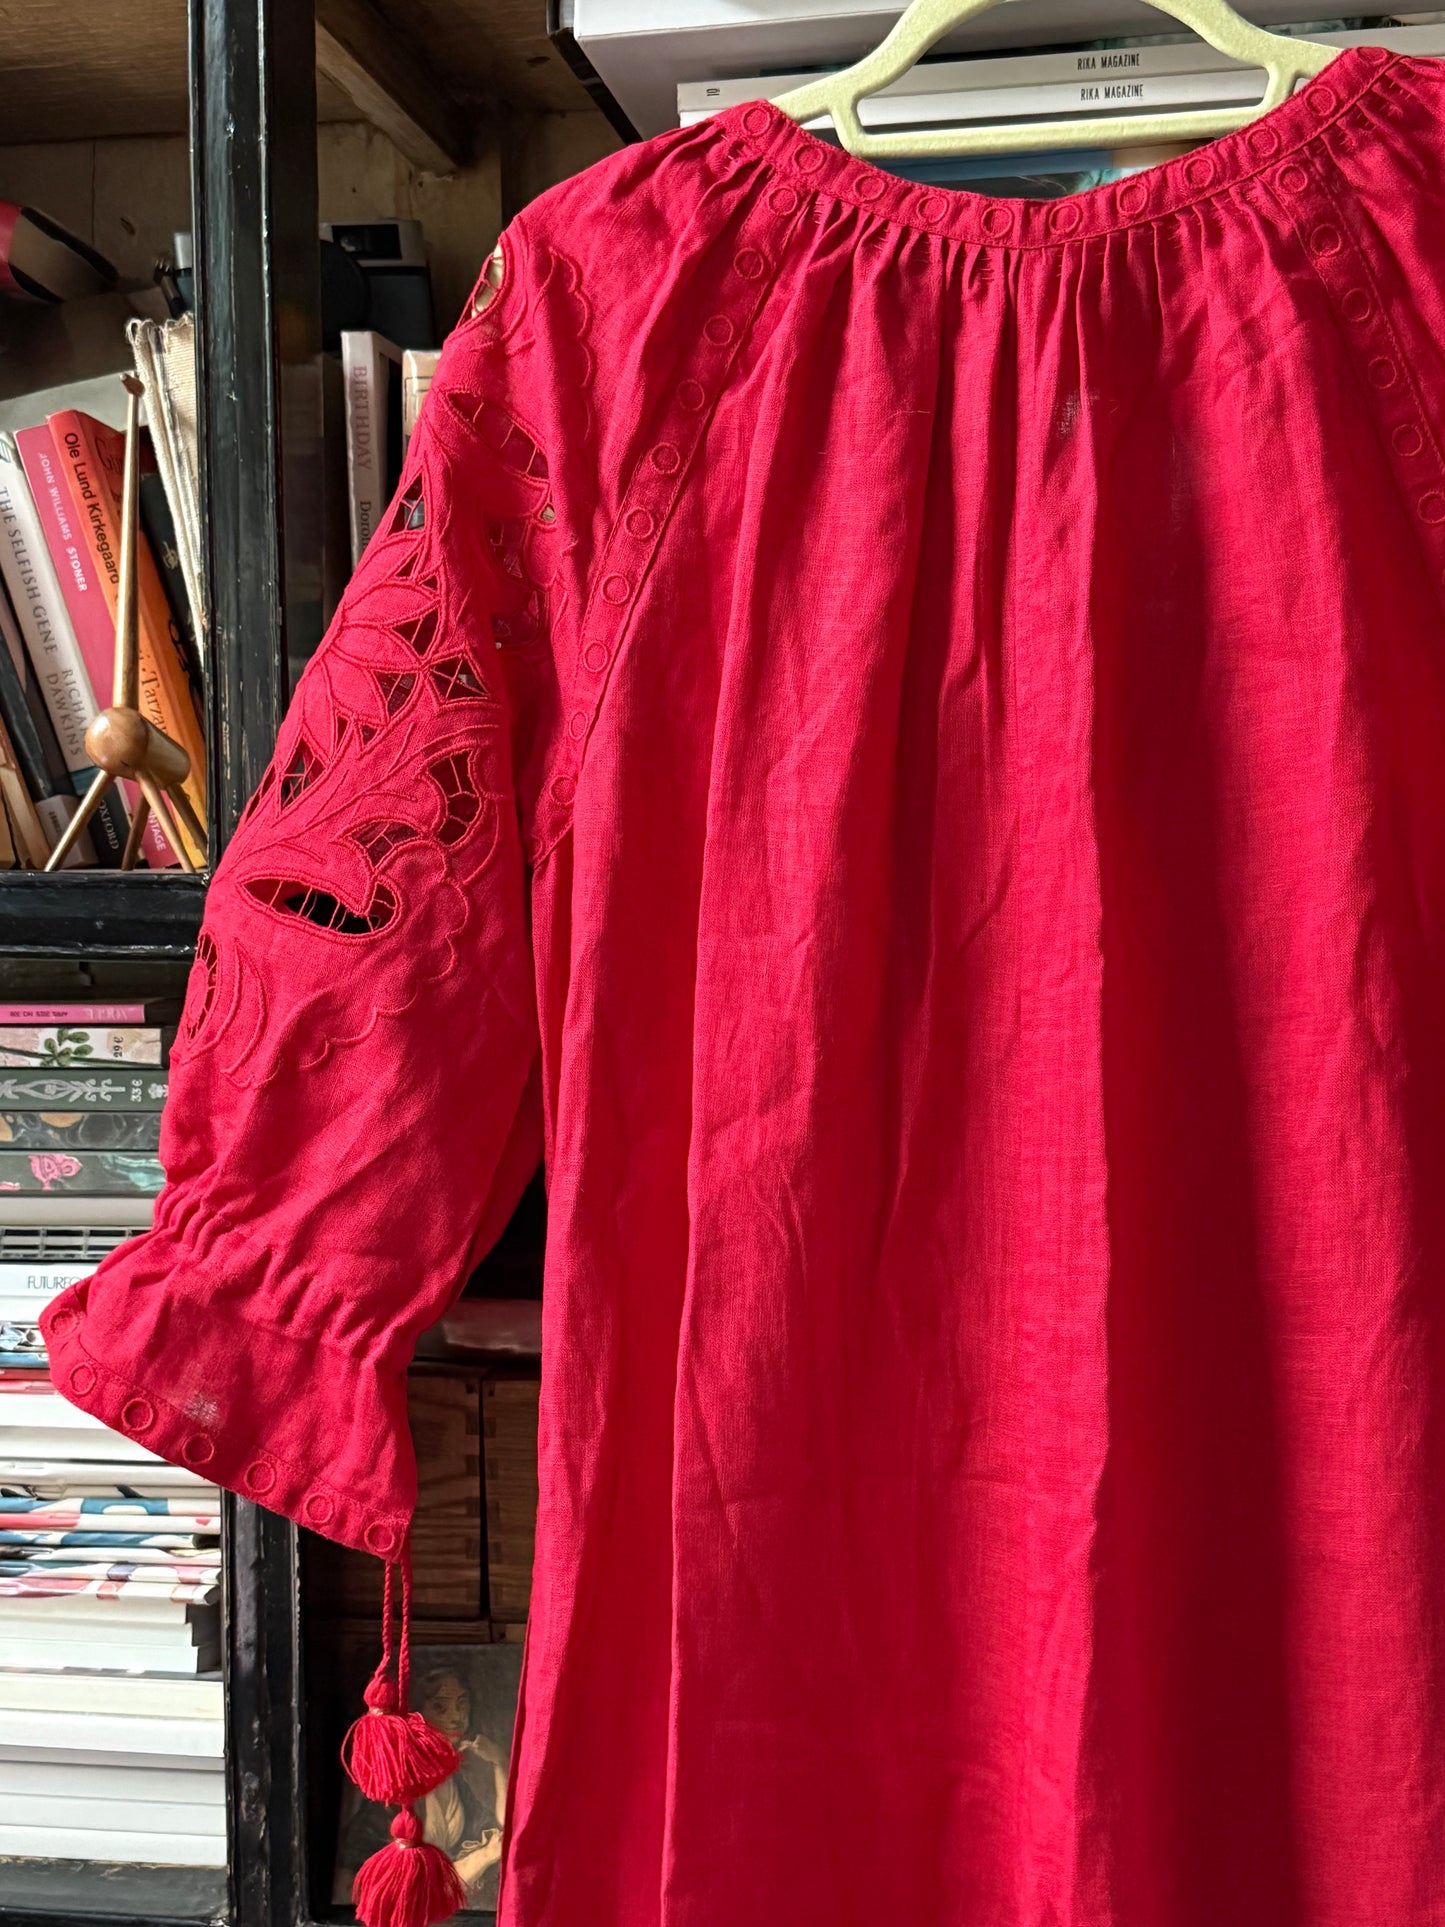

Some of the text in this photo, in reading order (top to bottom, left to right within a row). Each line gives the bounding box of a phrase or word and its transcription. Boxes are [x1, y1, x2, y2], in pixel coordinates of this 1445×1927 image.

[1078, 53, 1140, 70] RIKA MAGAZINE
[1081, 84, 1144, 101] RIKA MAGAZINE
[353, 366, 372, 471] BIRTHDAY
[64, 432, 81, 458] Ole
[73, 462, 97, 500] Lund
[38, 452, 88, 592] JOHN WILLIAMS STONER
[0, 486, 58, 655] THE SELFISH GENE
[46, 673, 80, 756] DAWKINS
[62, 668, 89, 734] RICHA
[98, 800, 119, 850] OXFORD
[148, 811, 167, 851] NTAGE
